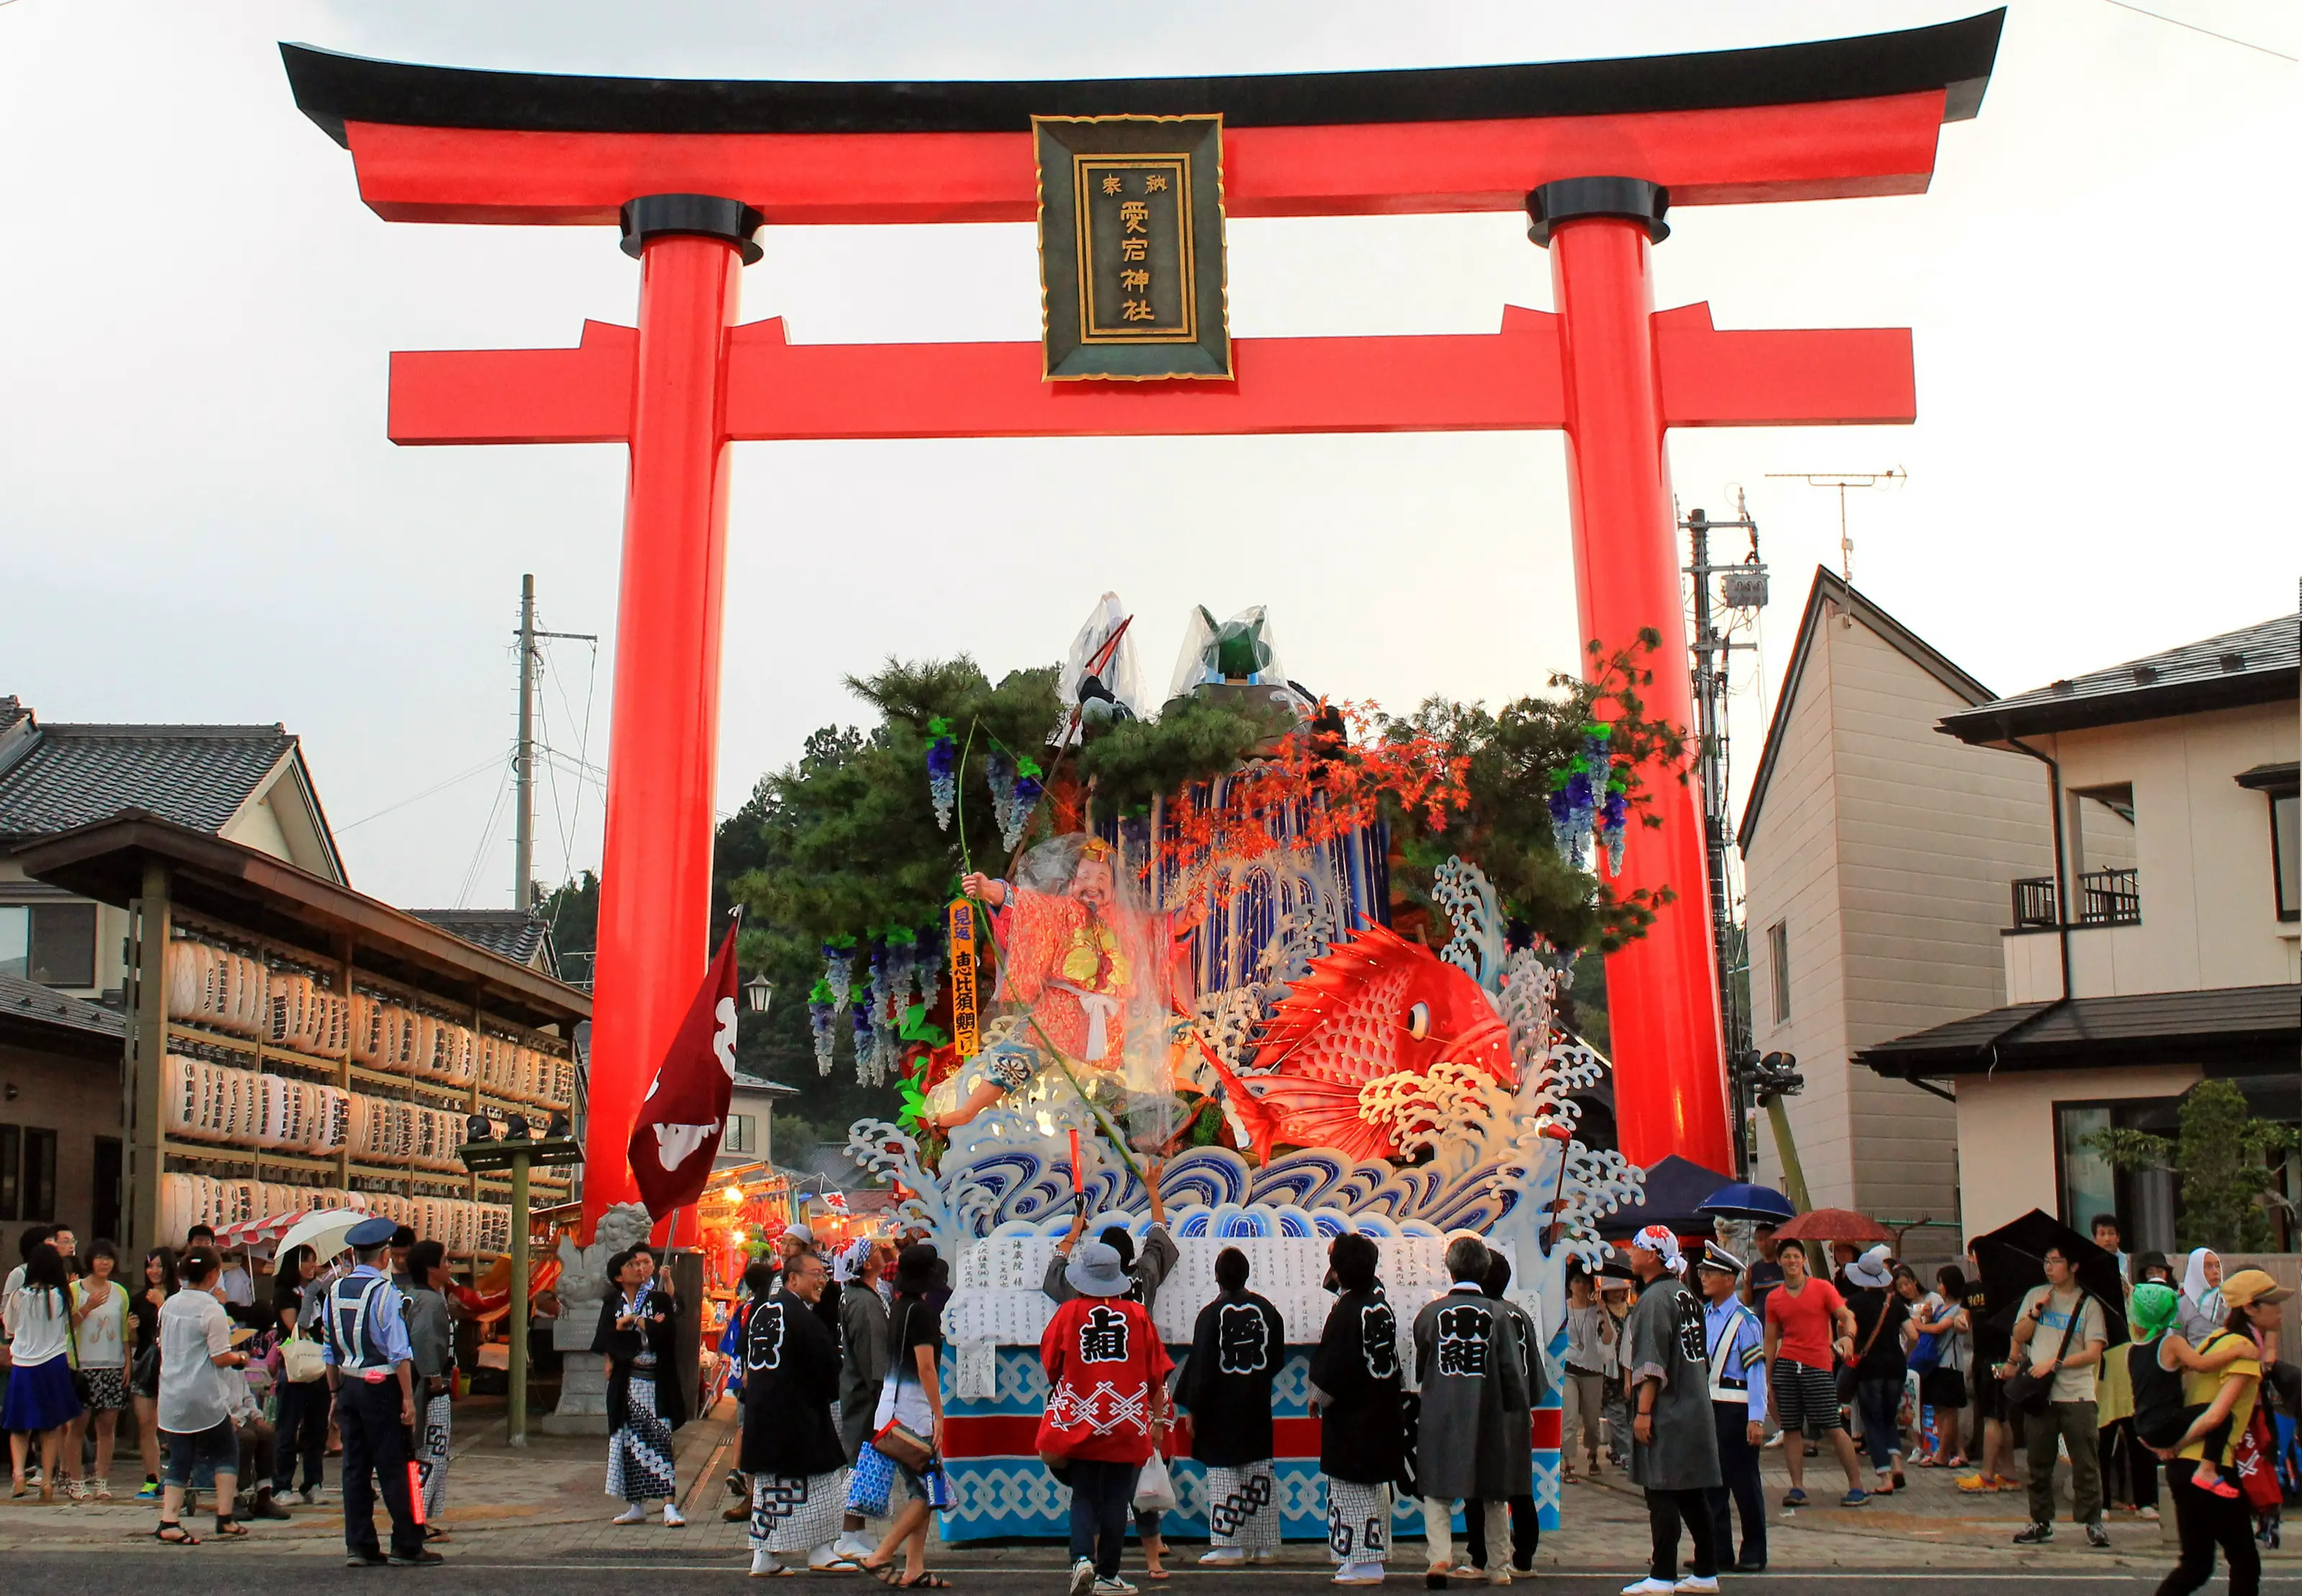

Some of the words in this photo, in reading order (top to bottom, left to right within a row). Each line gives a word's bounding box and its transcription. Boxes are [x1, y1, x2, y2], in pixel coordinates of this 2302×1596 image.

[1120, 201, 1155, 322] 愛宕神社
[1437, 1305, 1492, 1377] 中組
[927, 1474, 936, 1505] umbro
